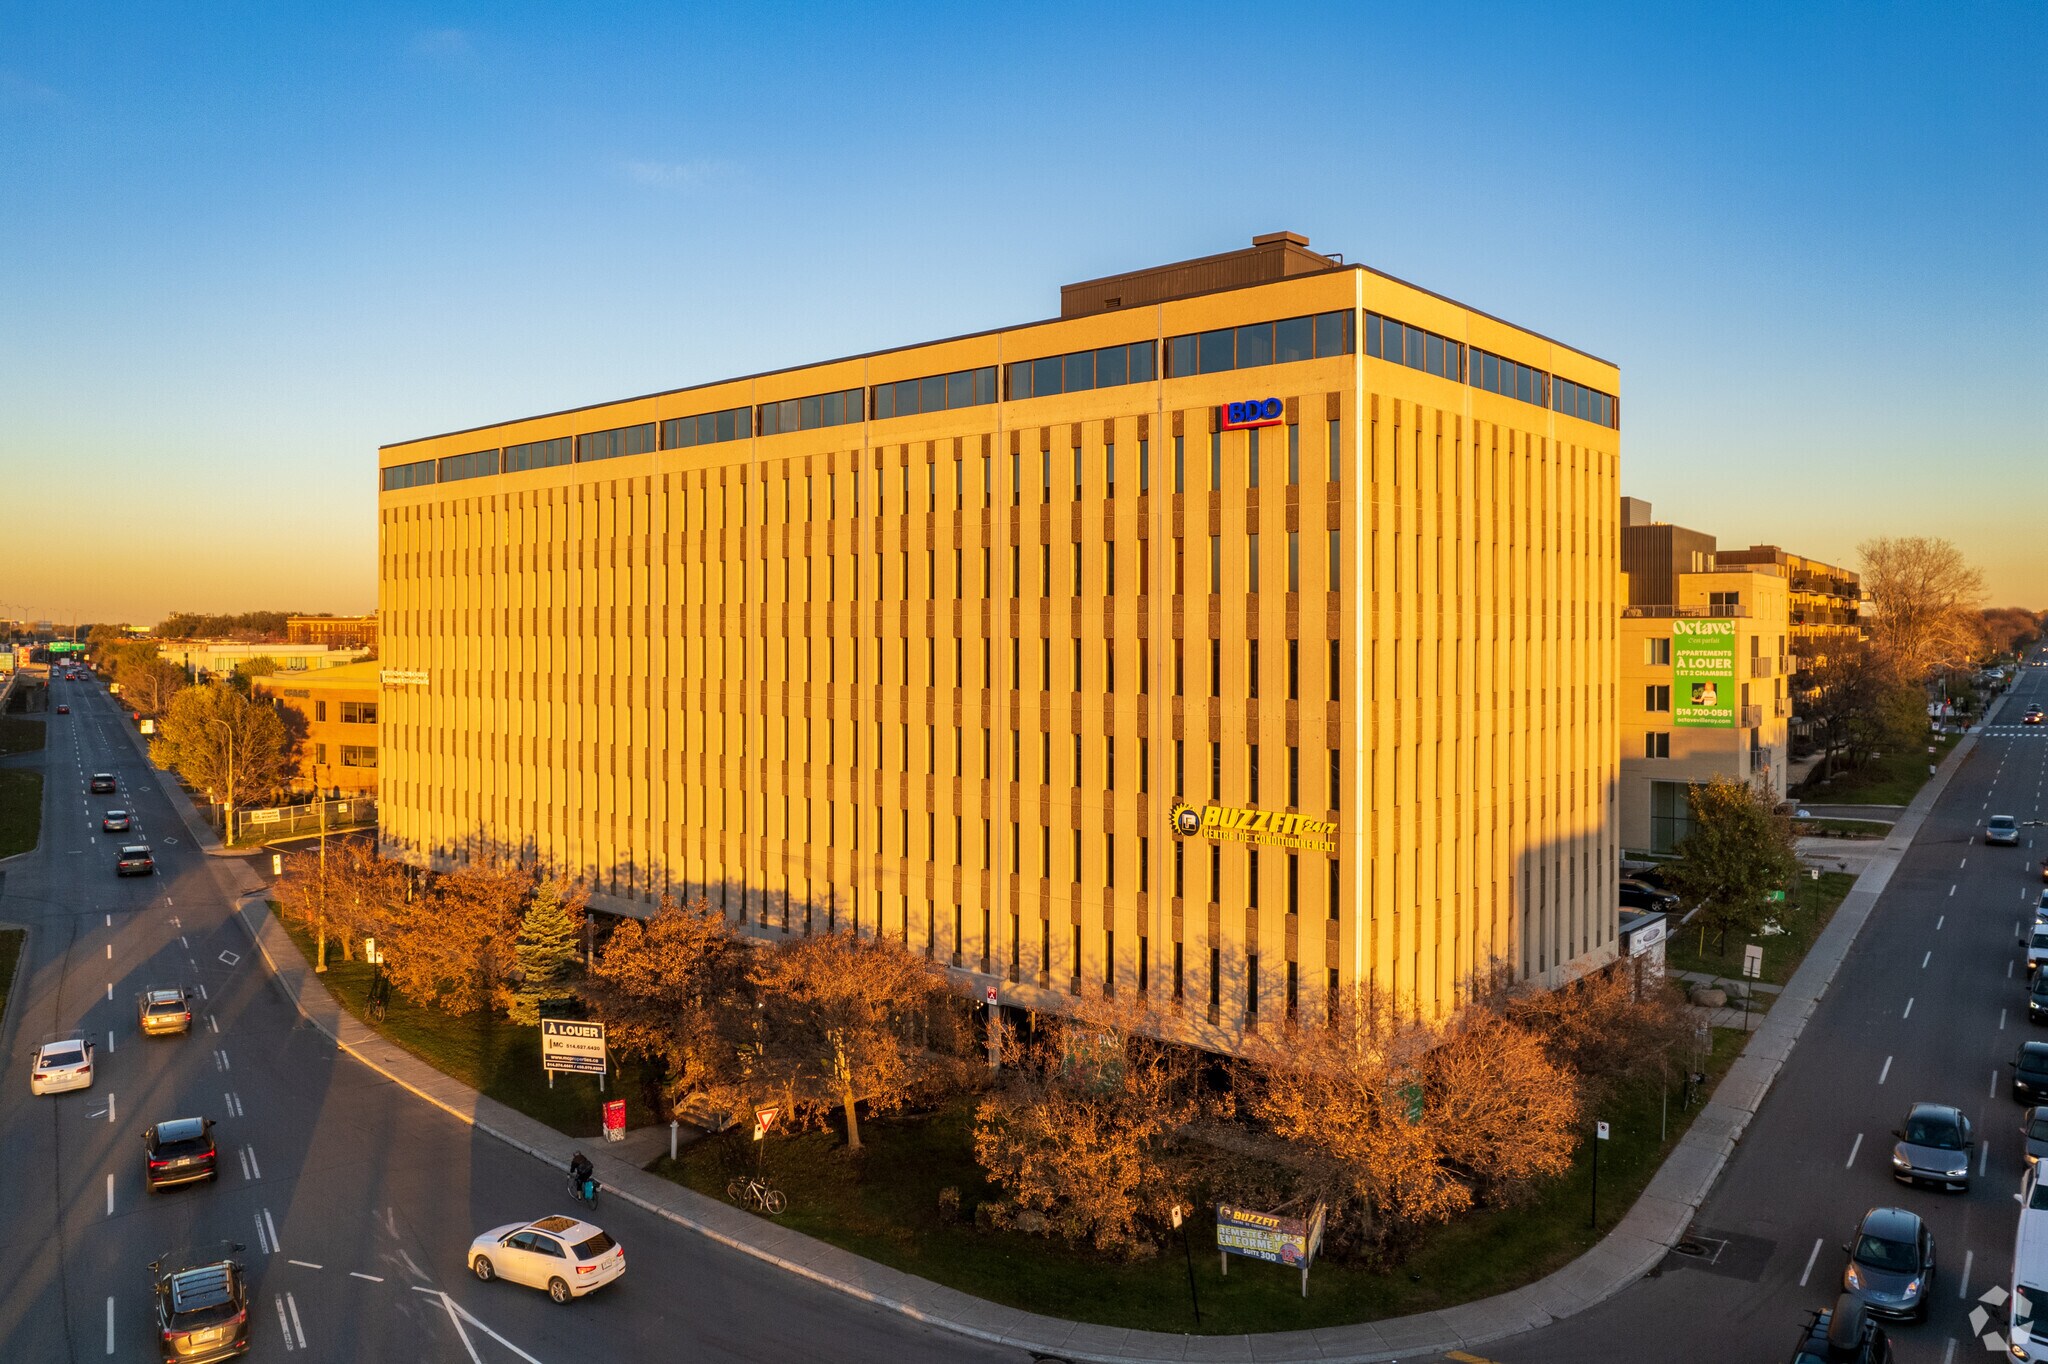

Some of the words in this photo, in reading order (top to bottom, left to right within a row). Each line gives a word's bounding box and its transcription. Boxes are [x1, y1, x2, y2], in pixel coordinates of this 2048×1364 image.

[1229, 397, 1283, 423] BDO
[1673, 620, 1736, 635] Octave!
[1677, 656, 1686, 668] À
[1689, 659, 1732, 669] LOUER
[1676, 708, 1691, 716] 514
[1692, 708, 1732, 717] 700-0581
[1202, 805, 1312, 836] BUZZFIT
[1303, 819, 1338, 834] 24/7
[1203, 828, 1234, 842] CENTRE
[1238, 832, 1250, 843] DE
[1254, 835, 1337, 853] CONDITIONNEMENT
[548, 1022, 557, 1034] À
[560, 1025, 599, 1037] LOUER
[1233, 1211, 1279, 1227] BUZZFIT
[1219, 1233, 1233, 1244] EN
[1243, 1248, 1259, 1257] SUITE
[1260, 1251, 1277, 1261] 300
